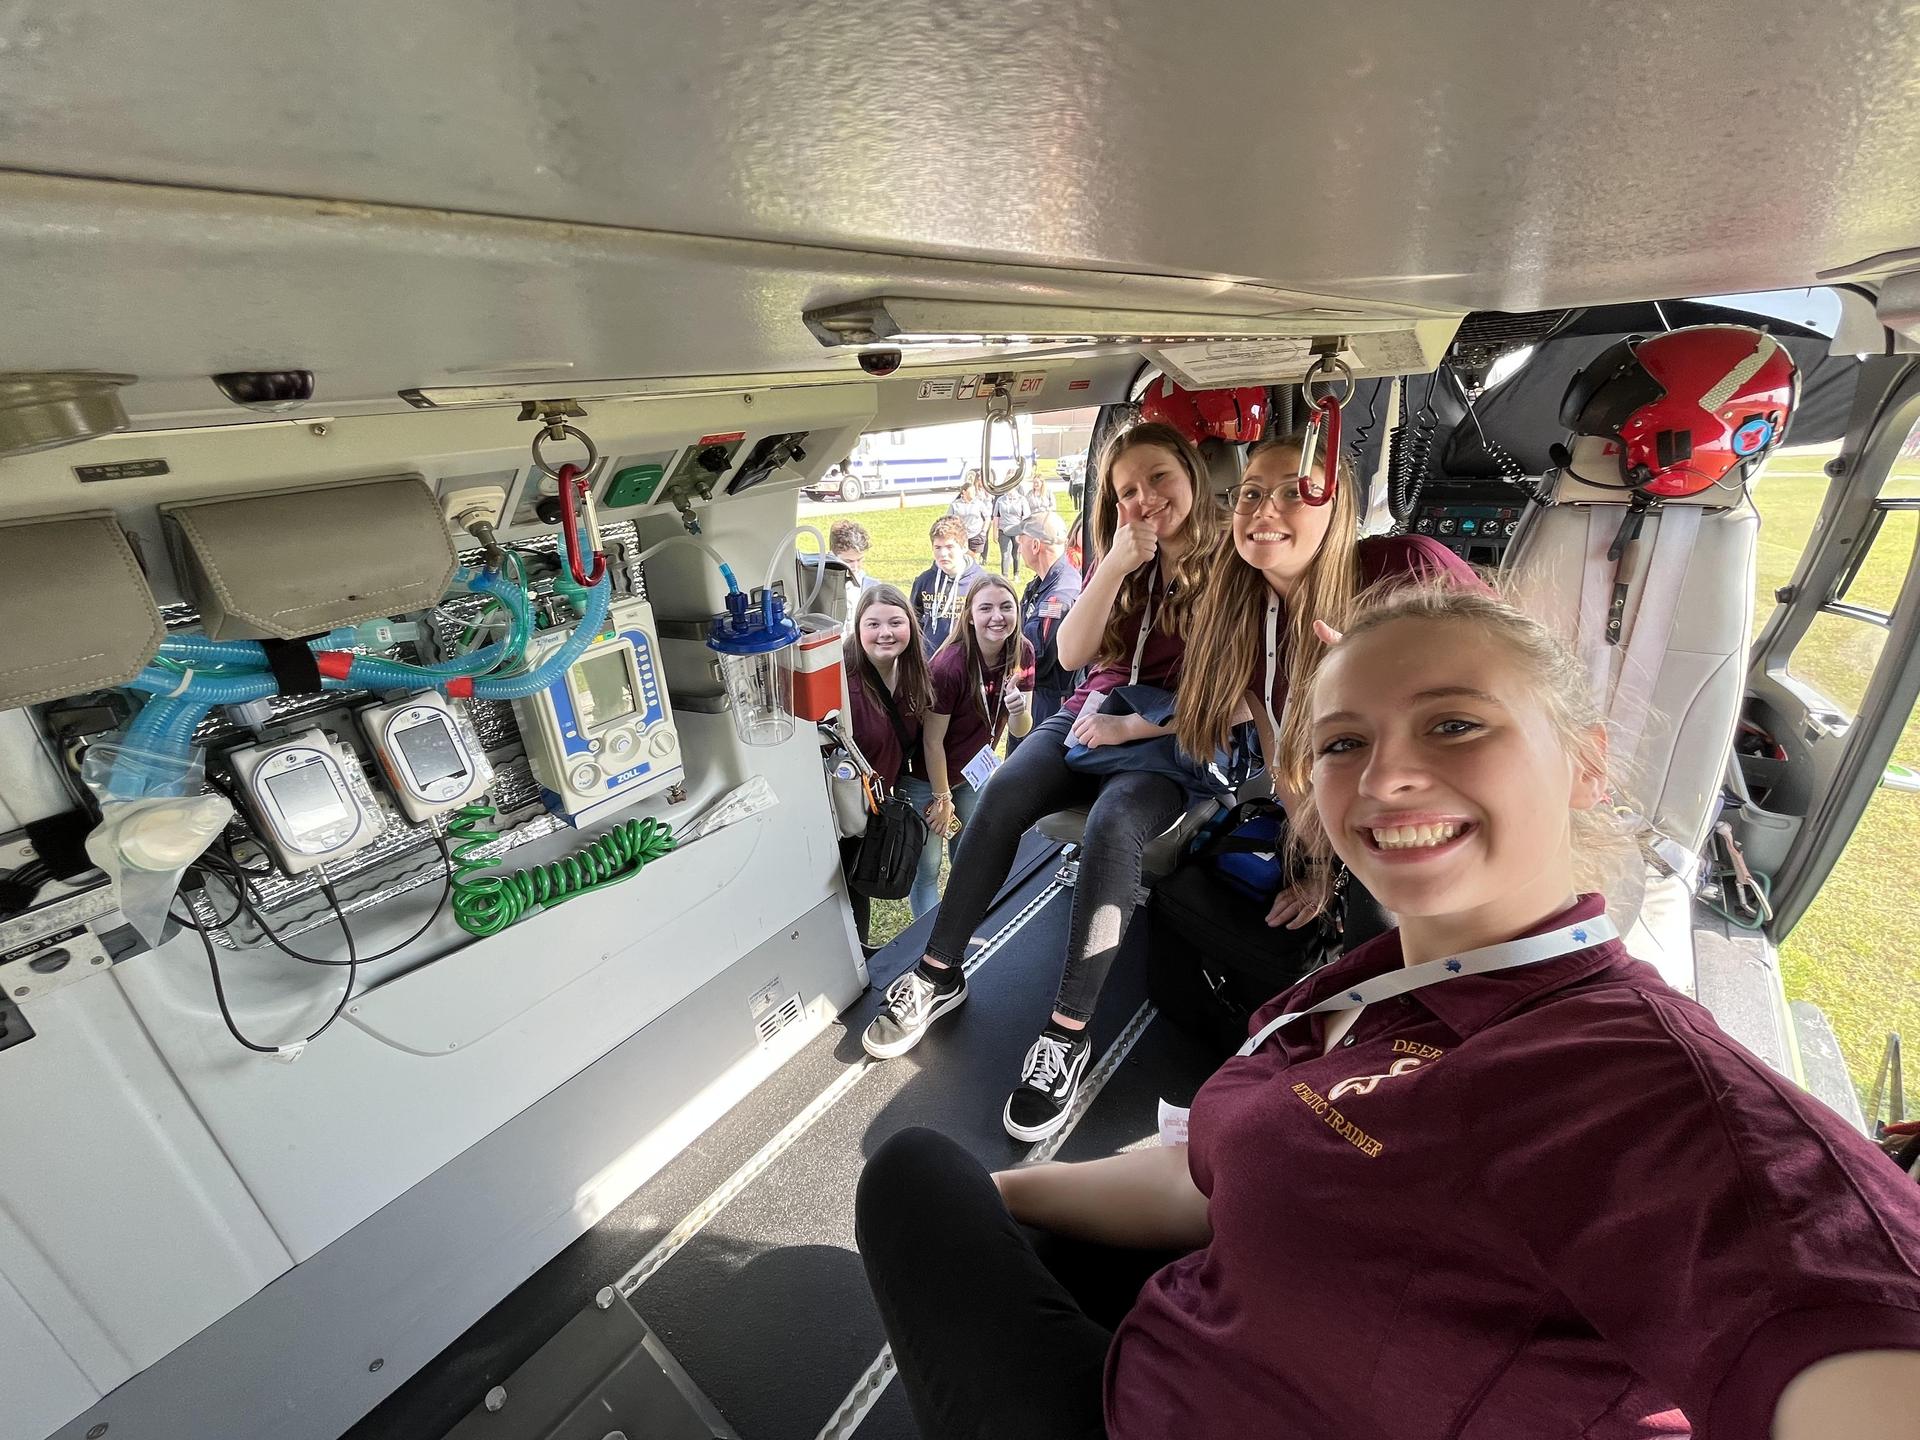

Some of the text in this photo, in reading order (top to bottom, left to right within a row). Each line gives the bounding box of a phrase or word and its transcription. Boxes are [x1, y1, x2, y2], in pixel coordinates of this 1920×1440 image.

[1020, 378, 1043, 391] EXIT
[617, 768, 640, 783] ZOLL
[1392, 1039, 1443, 1062] DEER
[1324, 1107, 1384, 1158] TRAINER
